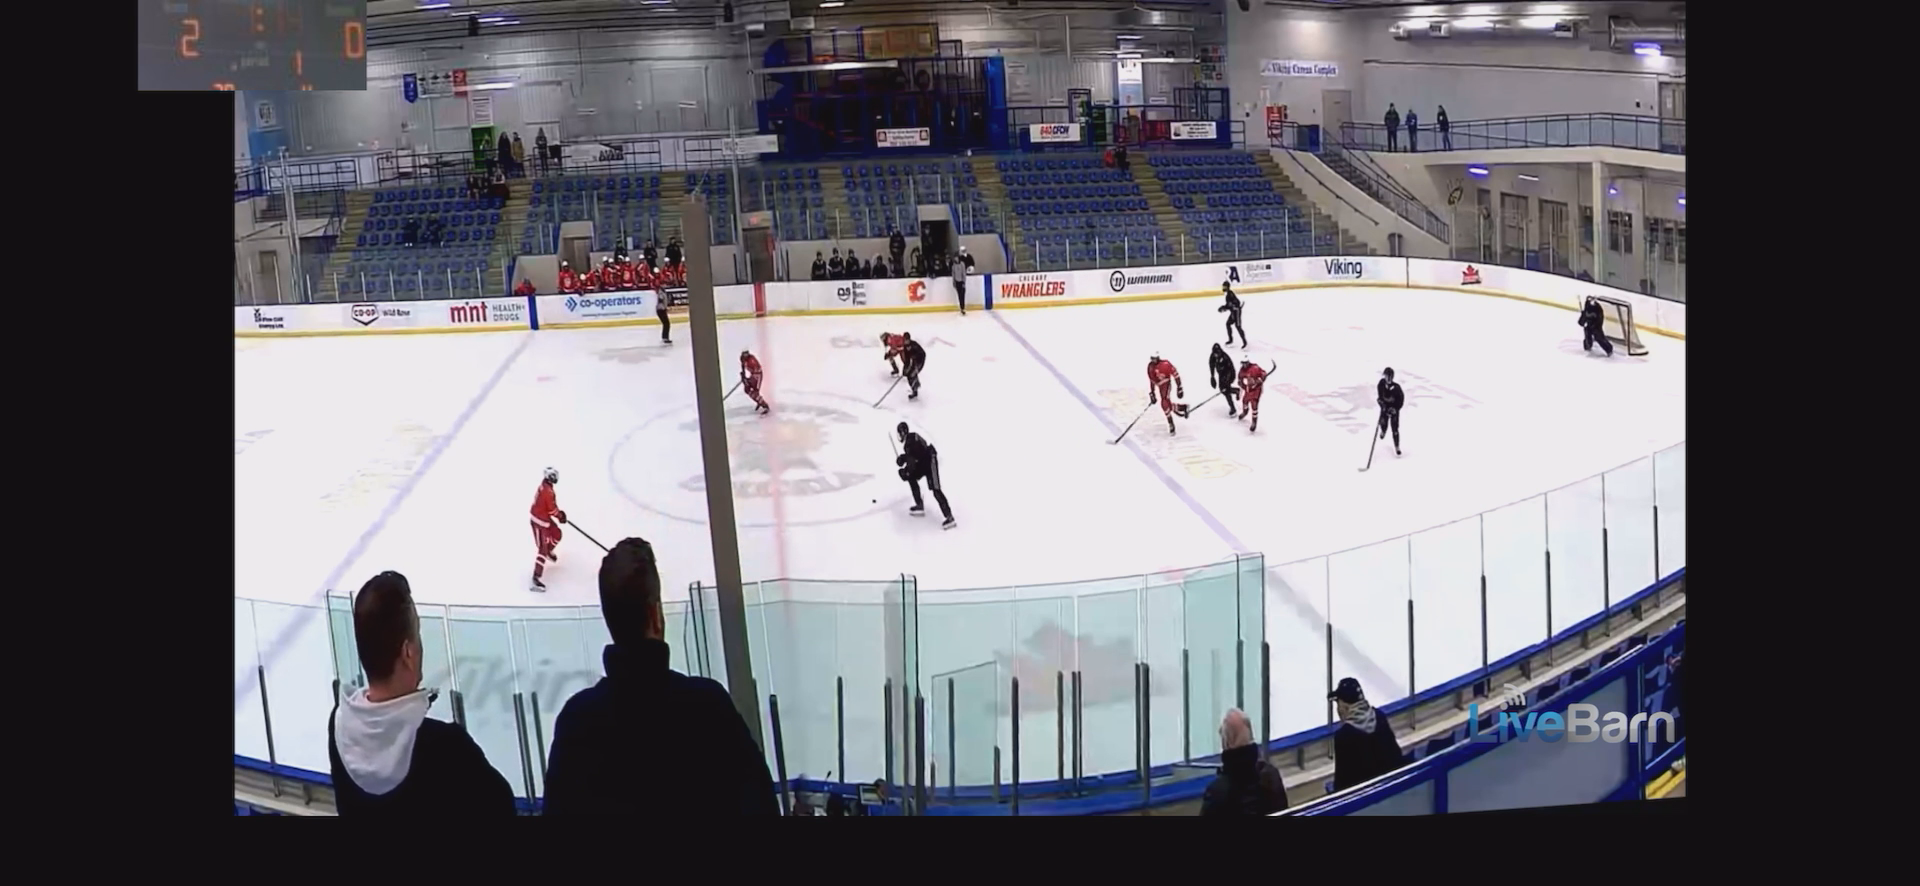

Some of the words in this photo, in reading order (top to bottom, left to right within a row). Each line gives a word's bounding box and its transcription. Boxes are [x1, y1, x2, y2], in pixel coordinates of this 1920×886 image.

[182, 19, 199, 57] 2
[345, 21, 363, 58] 0
[1325, 258, 1362, 279] Viking
[1019, 274, 1047, 282] CALGARY
[1127, 274, 1172, 285] WARRIOR
[1001, 281, 1065, 298] WRANGLERS
[580, 296, 641, 310] co-operators
[354, 309, 376, 317] CO-OP
[450, 302, 488, 323] mint
[493, 313, 519, 322] DRUGS
